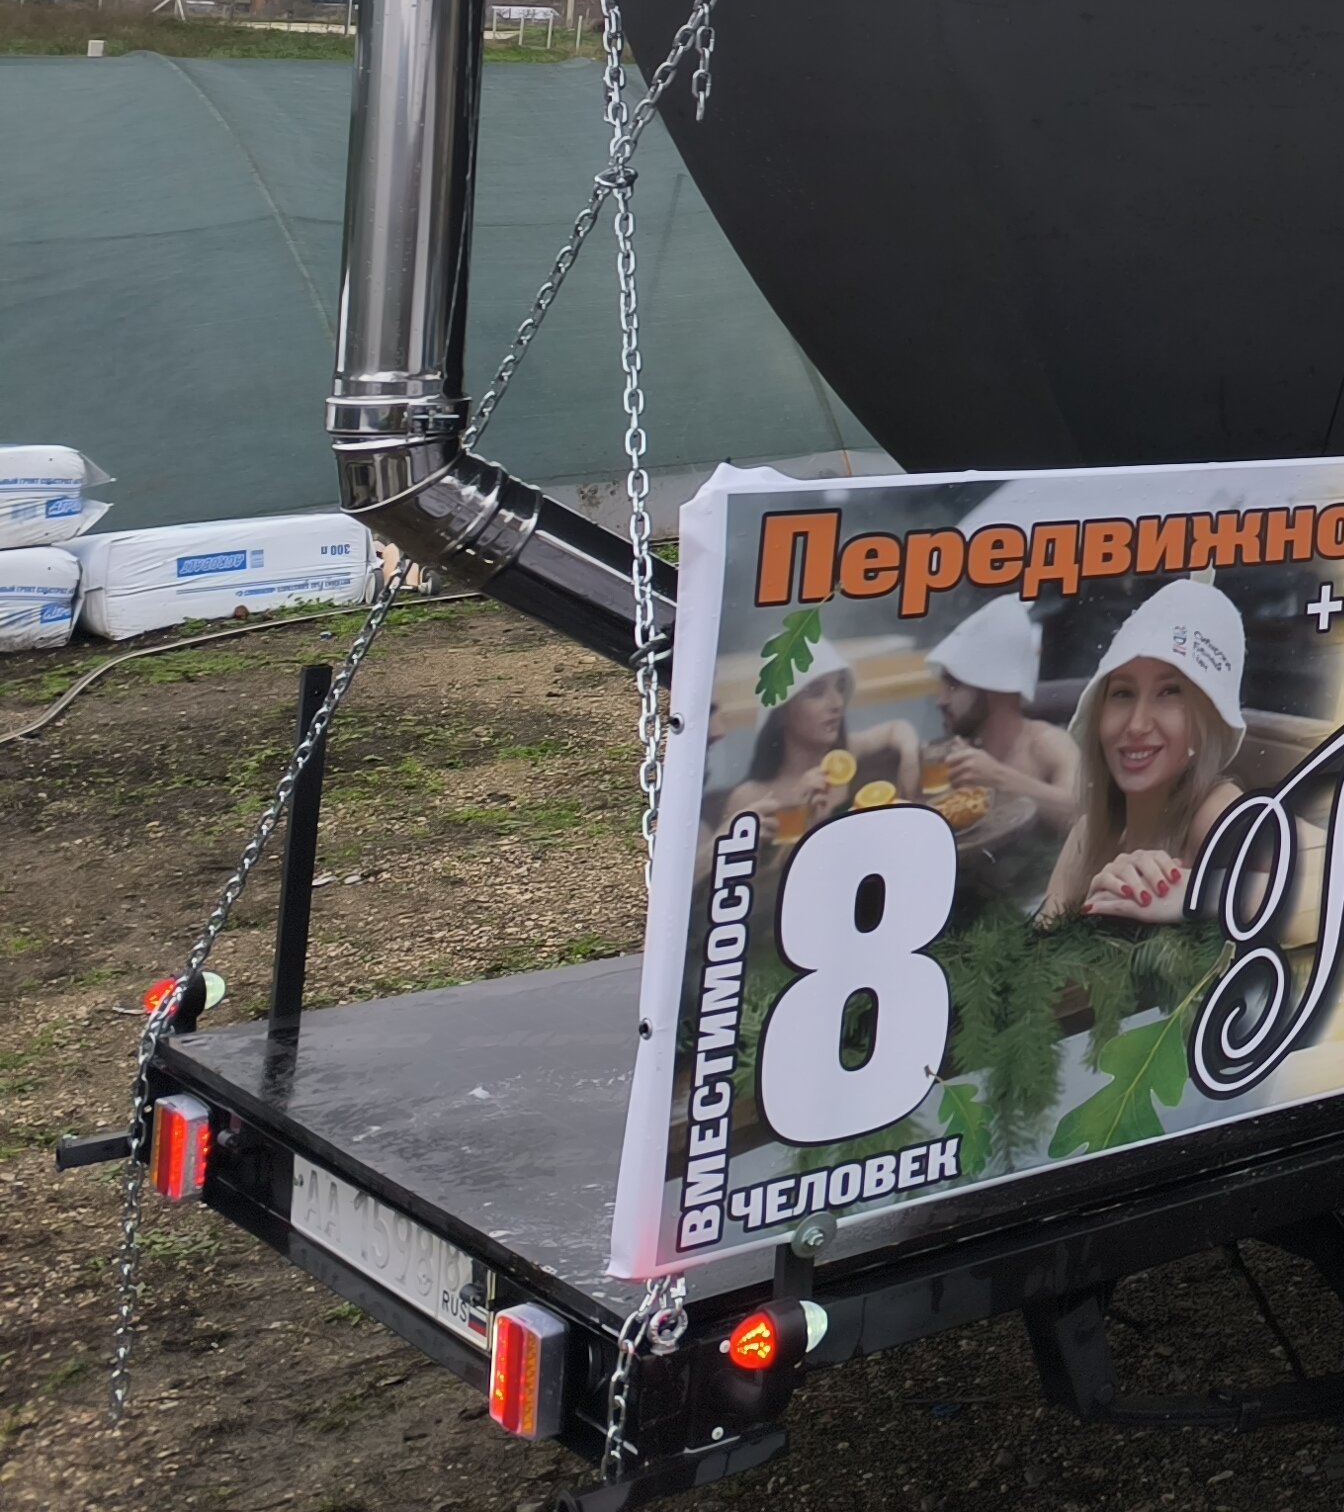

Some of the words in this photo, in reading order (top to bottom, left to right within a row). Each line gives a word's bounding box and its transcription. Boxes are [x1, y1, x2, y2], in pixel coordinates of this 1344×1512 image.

[330, 543, 351, 556] 300
[756, 803, 958, 1147] 8
[676, 811, 760, 1252] ВМЕСТИМОСТЬ
[727, 1133, 963, 1232] ЧЕЛОВЕК
[441, 1290, 468, 1323] RUS
